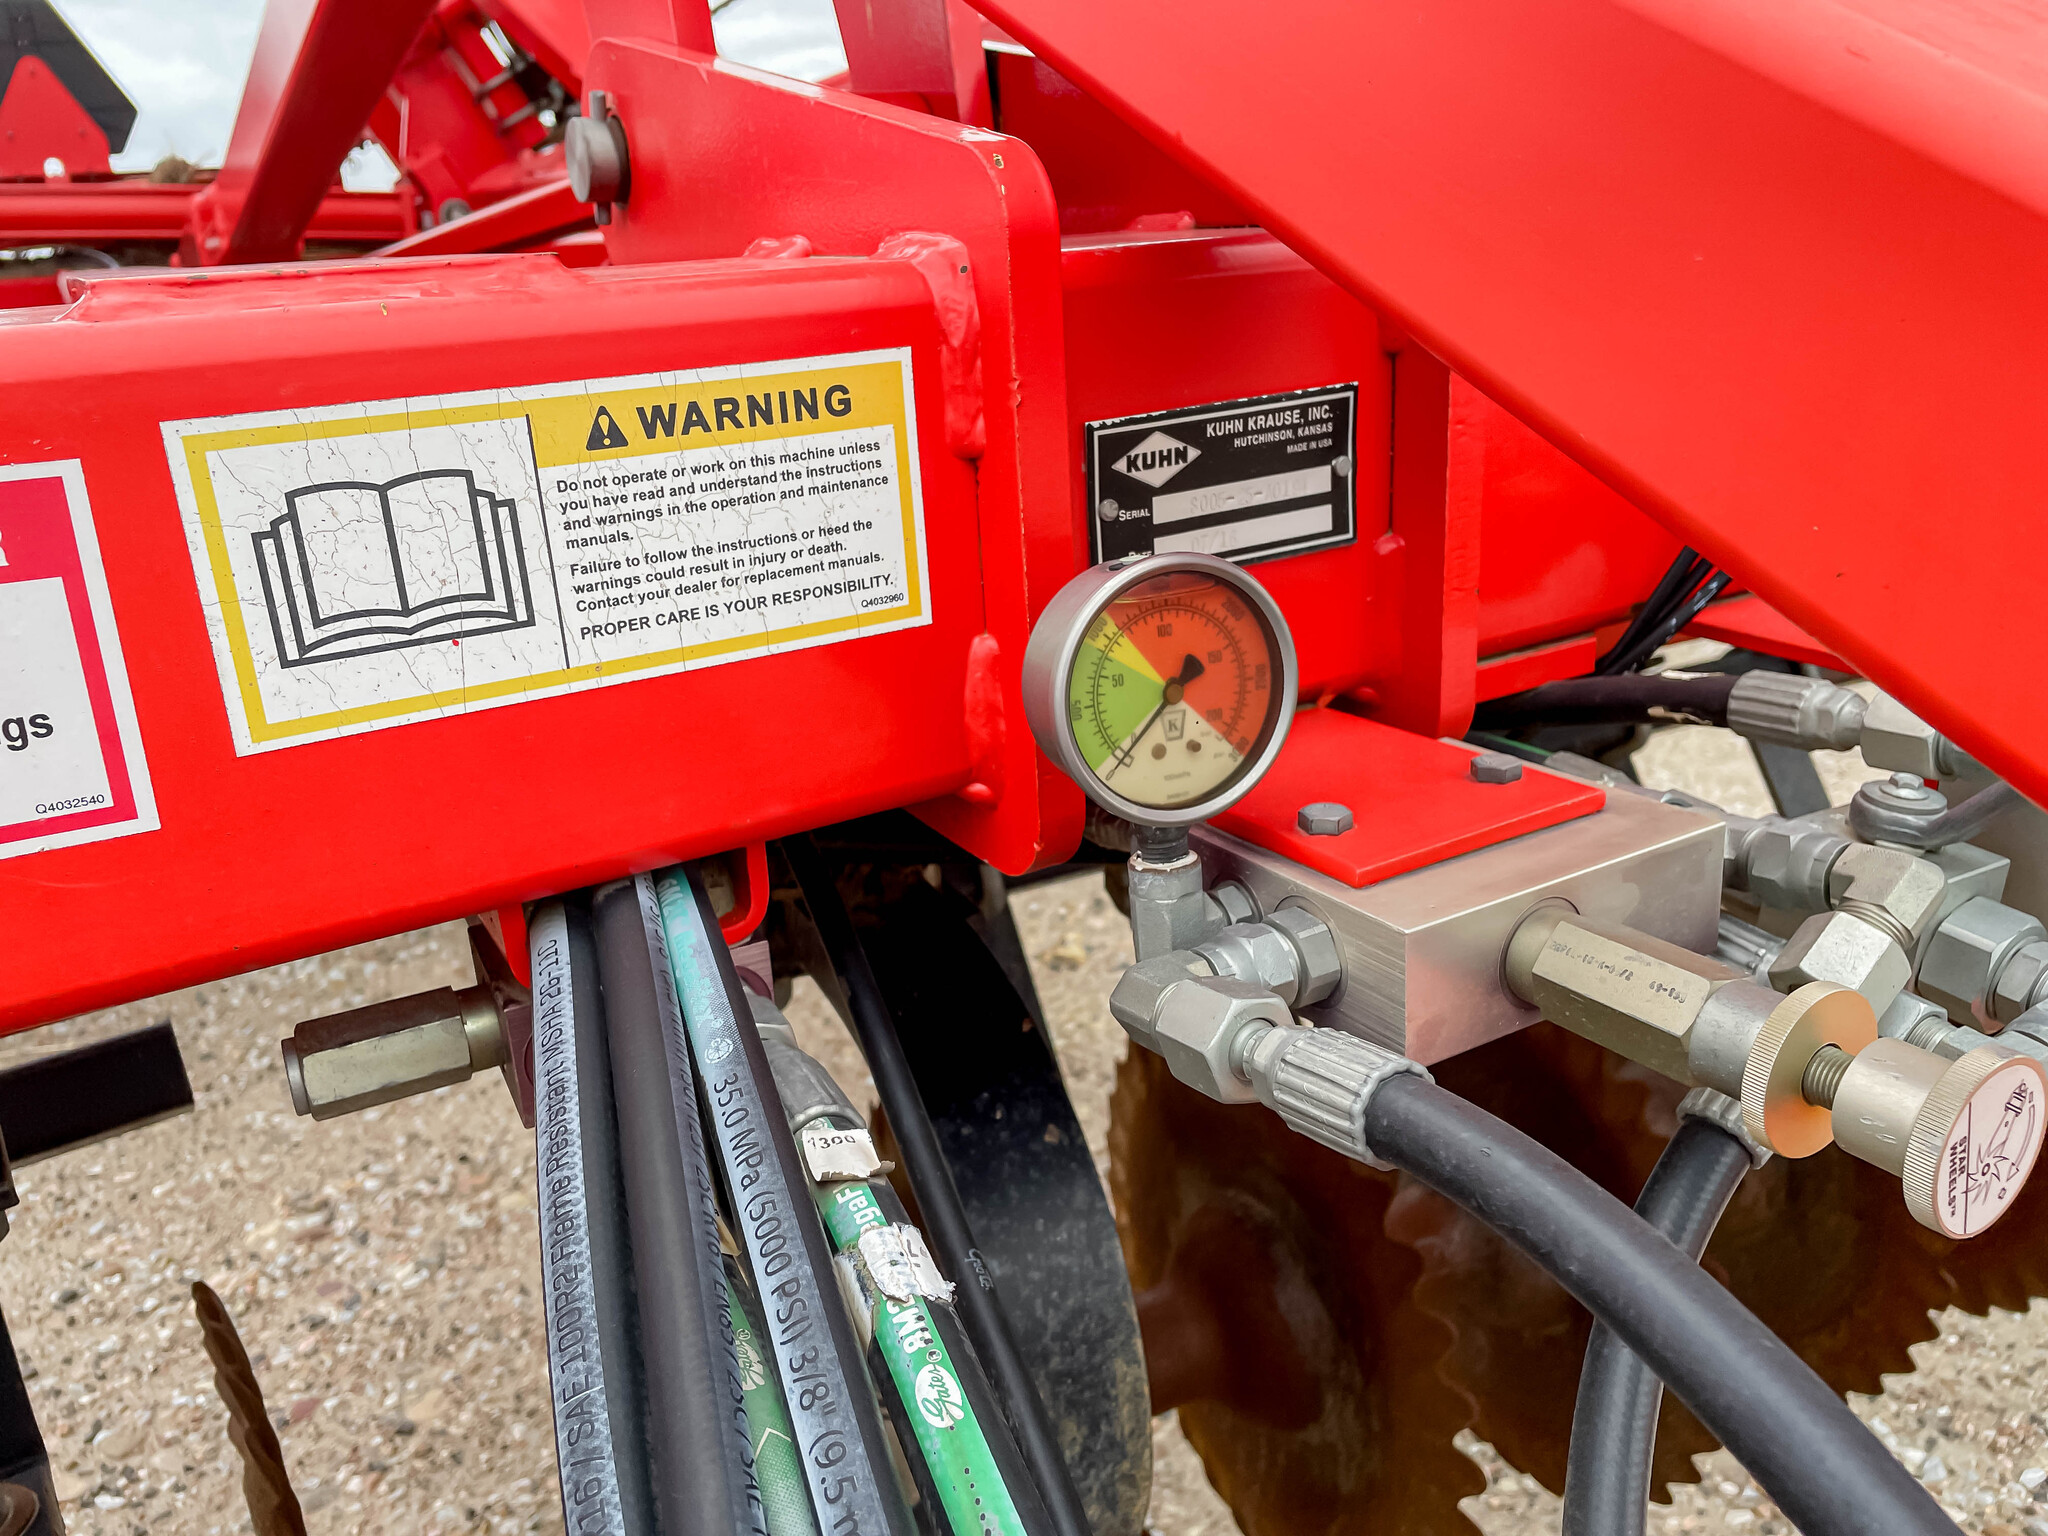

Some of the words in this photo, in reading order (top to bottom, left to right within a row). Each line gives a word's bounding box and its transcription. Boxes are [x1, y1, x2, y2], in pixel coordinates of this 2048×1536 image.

[634, 383, 853, 441] WARNING
[1207, 418, 1244, 437] KUHN
[1248, 408, 1304, 430] KRAUSE,
[1308, 404, 1333, 420] INC.
[1234, 431, 1295, 448] HUTCHINSON,
[1297, 422, 1333, 437] KANSAS
[555, 479, 579, 494] Do
[582, 474, 610, 491] not
[611, 468, 668, 488] operate
[670, 466, 688, 479] or
[689, 459, 726, 476] work
[728, 458, 747, 471] on
[749, 454, 777, 469] this
[778, 447, 836, 465] machine
[837, 441, 882, 457] unless
[1126, 445, 1188, 474] KUHN
[1287, 443, 1307, 453] MADE
[1308, 441, 1317, 450] IN
[1318, 438, 1333, 449] USA
[558, 498, 589, 516] you
[591, 493, 629, 509] have
[632, 485, 666, 503] read
[668, 480, 697, 498] and
[699, 469, 779, 494] understand
[780, 468, 803, 483] the
[805, 458, 883, 479] instructions
[562, 514, 592, 532] and
[594, 507, 664, 527] warnings
[666, 504, 682, 517] in
[683, 499, 708, 515] the
[710, 491, 777, 513] operation
[779, 484, 805, 501] and
[807, 475, 890, 497] maintenance
[565, 529, 634, 551] manuals.
[569, 559, 622, 578] Failure
[624, 555, 641, 569] to
[643, 548, 689, 566] follow
[690, 544, 714, 558] the
[716, 531, 799, 554] instructions
[800, 528, 816, 541] or
[817, 520, 851, 538] heed
[851, 518, 873, 533] the
[571, 574, 642, 596] warnings
[644, 564, 686, 584] could
[688, 558, 730, 577] result
[731, 557, 746, 570] in
[748, 551, 787, 568] injury
[789, 548, 805, 560] or
[806, 539, 847, 557] death.
[575, 591, 636, 613] Contact
[636, 587, 671, 607] your
[673, 579, 718, 597] dealer
[719, 575, 741, 589] for
[743, 559, 826, 586] replacement
[827, 550, 885, 571] manuals.
[579, 615, 652, 641] PROPER
[654, 606, 702, 627] CARE
[704, 603, 721, 619] IS
[722, 595, 769, 615] YOUR
[771, 572, 895, 607] RESPONSIBILITY.
[860, 591, 905, 609] Q4032960
[1156, 623, 1173, 638] 100
[1111, 673, 1125, 688] 50
[1071, 700, 1083, 722] 500
[1167, 719, 1180, 733] K
[35, 794, 105, 816] Q4032540
[537, 938, 563, 1008] 2G-11C
[540, 1001, 564, 1067] MSHA
[544, 1061, 571, 1179] Resistant
[713, 1072, 750, 1129] 35.0
[729, 1127, 764, 1193] MPa
[807, 1134, 857, 1151] 1300
[1957, 1135, 1968, 1179] STAR
[550, 1175, 578, 1268] Flame
[744, 1191, 794, 1277] (5000
[553, 1264, 588, 1373] 100R2
[771, 1276, 813, 1346] PSI)
[789, 1345, 837, 1417] 3/8"
[920, 1364, 963, 1427] Gates
[565, 1374, 594, 1448] SAE
[808, 1429, 858, 1505] (9.5
